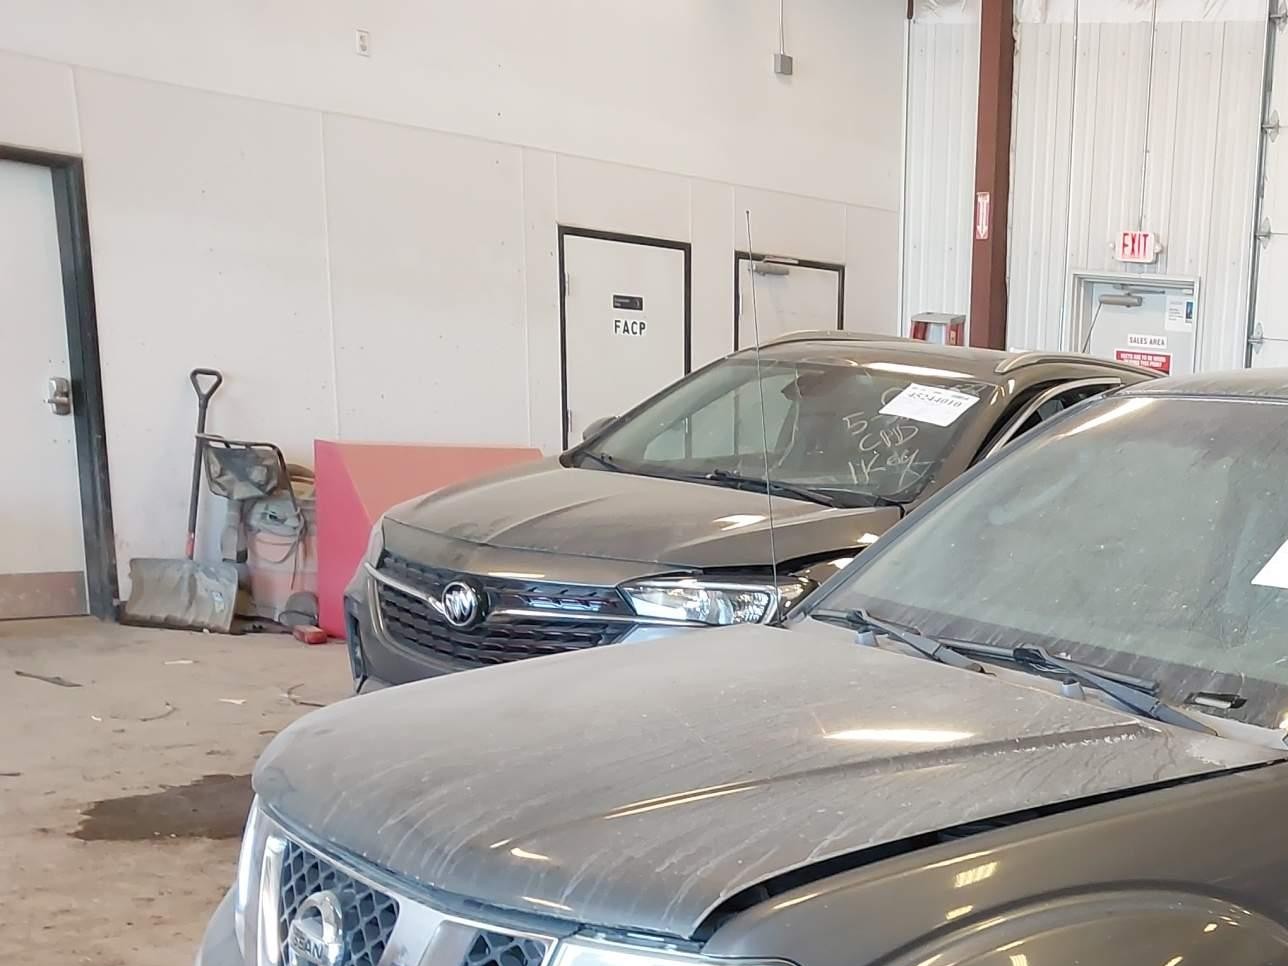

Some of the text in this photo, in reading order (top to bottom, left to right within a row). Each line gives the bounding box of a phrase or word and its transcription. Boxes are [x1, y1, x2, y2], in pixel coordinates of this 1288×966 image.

[1121, 232, 1150, 258] EXIT
[614, 319, 646, 336] FACP
[1129, 336, 1165, 346] SALES AREA
